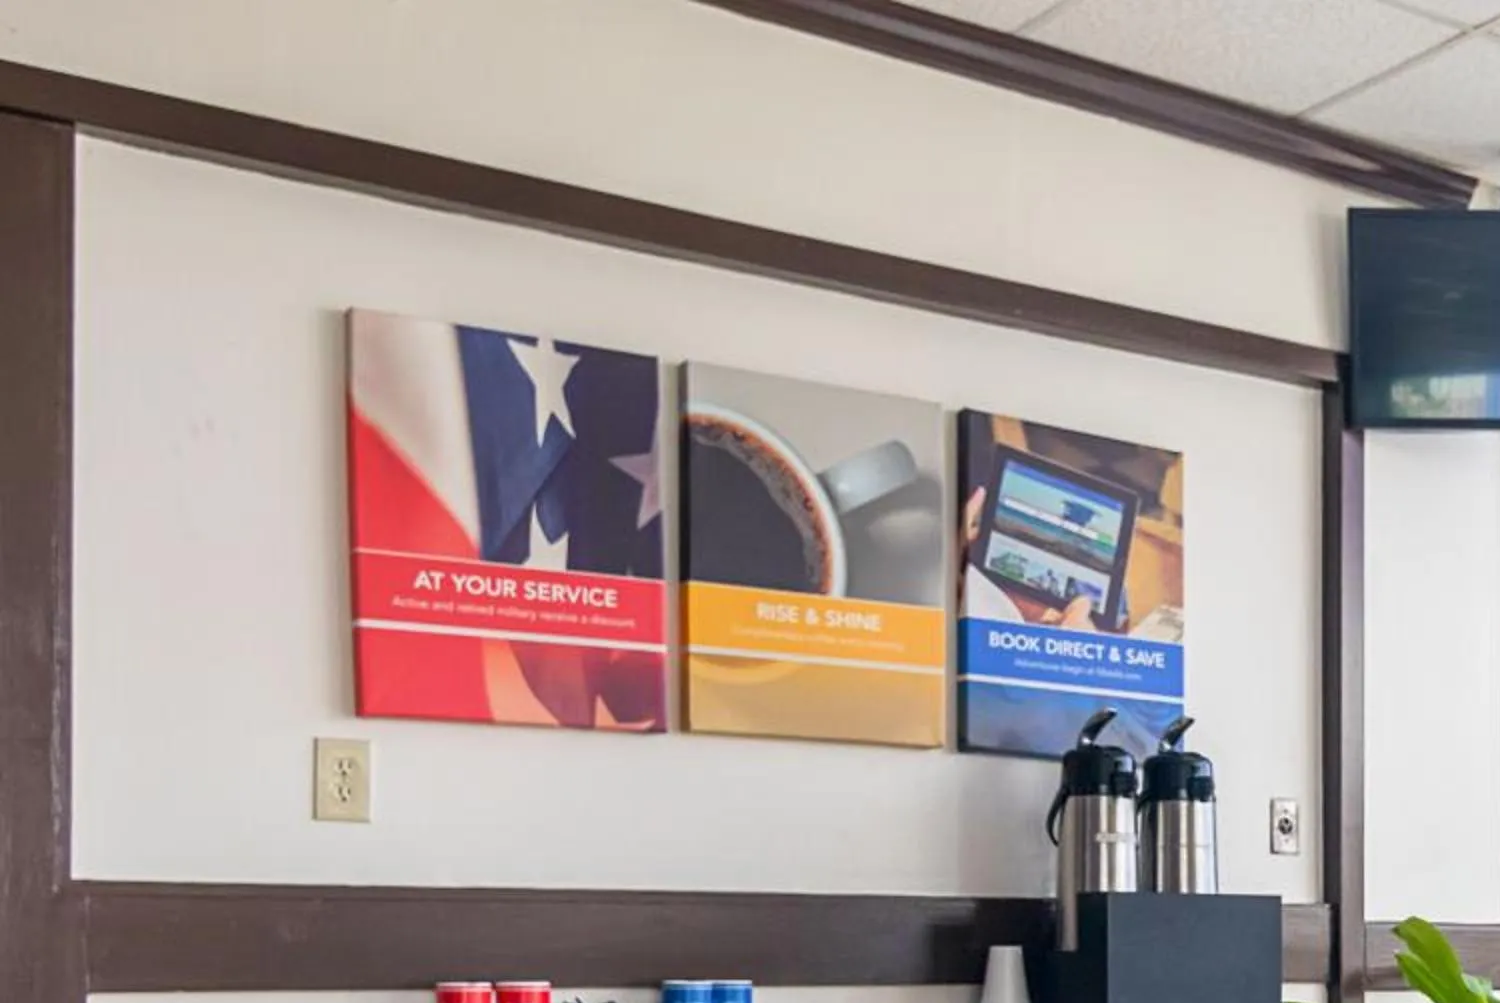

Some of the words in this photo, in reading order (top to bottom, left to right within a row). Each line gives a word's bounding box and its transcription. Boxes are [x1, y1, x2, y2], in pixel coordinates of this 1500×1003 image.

[414, 570, 445, 591] AT
[450, 573, 517, 598] YOUR
[523, 579, 618, 608] SERVICE
[755, 602, 799, 623] RISE
[805, 607, 819, 625] &
[824, 608, 882, 632] SHINE
[989, 630, 1040, 652] BOOK
[1044, 637, 1104, 661] DIRECT
[1108, 646, 1120, 662] &
[1125, 647, 1165, 668] SAVE
